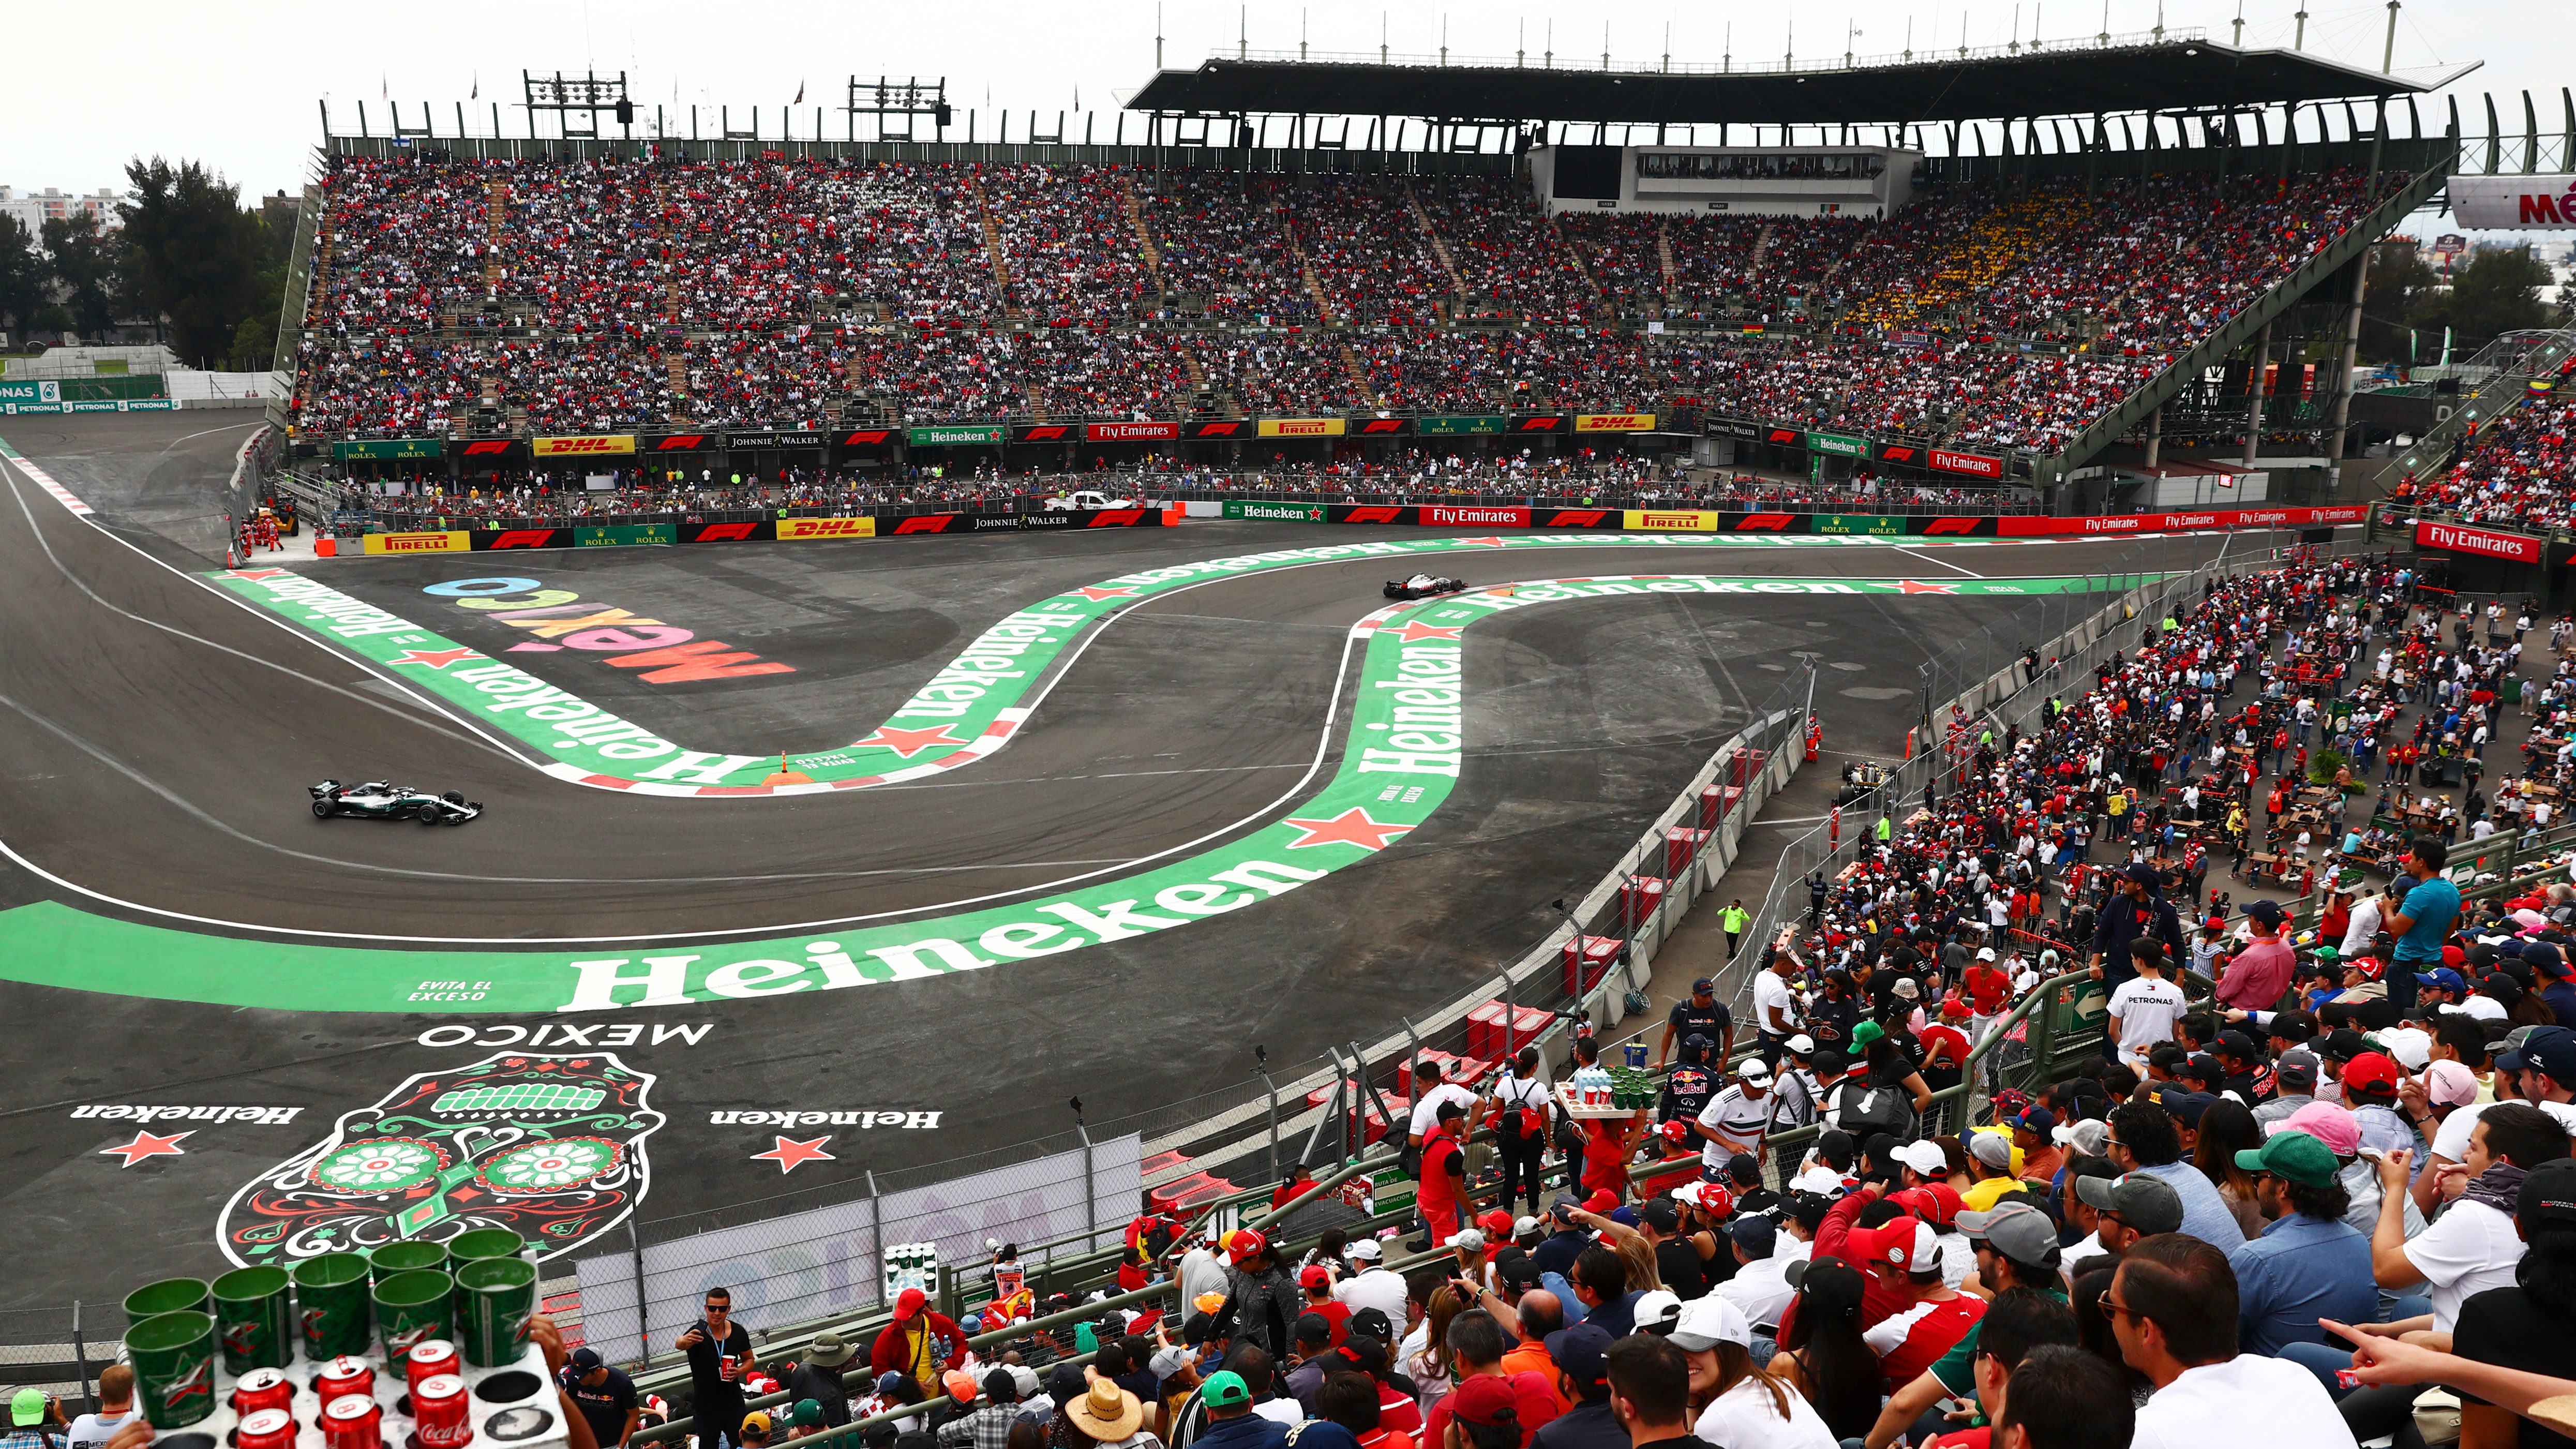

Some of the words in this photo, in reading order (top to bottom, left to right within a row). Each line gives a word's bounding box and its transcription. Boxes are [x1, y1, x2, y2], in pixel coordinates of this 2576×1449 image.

[2436, 405, 2453, 422] D
[1279, 422, 1326, 434] PIRELLI
[1589, 417, 1637, 428] DHL
[1708, 423, 1730, 432] JOHNNIE
[1733, 427, 1755, 436] WALKER
[931, 431, 985, 442] Heineken
[1100, 427, 1118, 438] Fly
[1121, 426, 1169, 436] Emirates
[548, 439, 612, 452] DHL
[731, 438, 773, 447] JOHNNIE
[781, 437, 818, 445] WALKER
[1820, 438, 1855, 453] Heineken
[1937, 454, 1951, 468] Fly
[1953, 457, 1990, 472] Emirates
[1244, 505, 1305, 519] Heineken
[1434, 510, 1455, 523] Fly
[1459, 510, 1517, 522] Emirates
[2240, 513, 2253, 525] Fly
[2254, 512, 2286, 522] Emirates
[2311, 510, 2323, 521] Fly
[2325, 509, 2356, 519] Emirates
[792, 520, 856, 536] DHL
[975, 518, 1018, 529] JOHNNIE
[1643, 514, 1699, 528] PIRELLI
[2086, 520, 2101, 531] Fly
[2102, 518, 2138, 529] Emirates
[2165, 516, 2180, 528] Fly
[2181, 515, 2214, 526] Emirates
[384, 535, 448, 550] PIRELLI
[2431, 527, 2455, 546] Fly
[2458, 531, 2523, 555] Emirates
[1105, 542, 1415, 585] Heineken
[1446, 578, 1863, 610] Heineken
[256, 573, 424, 637] Heineken
[892, 611, 1087, 719] Heineken
[1357, 646, 1462, 777] Heineken
[450, 662, 767, 784] Heineken
[795, 754, 848, 765] EXCESO
[1400, 786, 1425, 803] EXCESO
[557, 859, 1328, 1012] Heineken
[417, 981, 469, 991] EVITA
[473, 981, 492, 990] EL
[2089, 987, 2104, 996] RUTA
[407, 991, 486, 1002] EXCESO
[2129, 997, 2174, 1006] PETRONAS
[417, 1023, 715, 1047] MEXICO
[70, 1105, 305, 1125] Heineken
[711, 1110, 942, 1129] Heineken
[2024, 1121, 2038, 1132] MESSI
[1374, 1193, 1410, 1207] EVACUACIÓN
